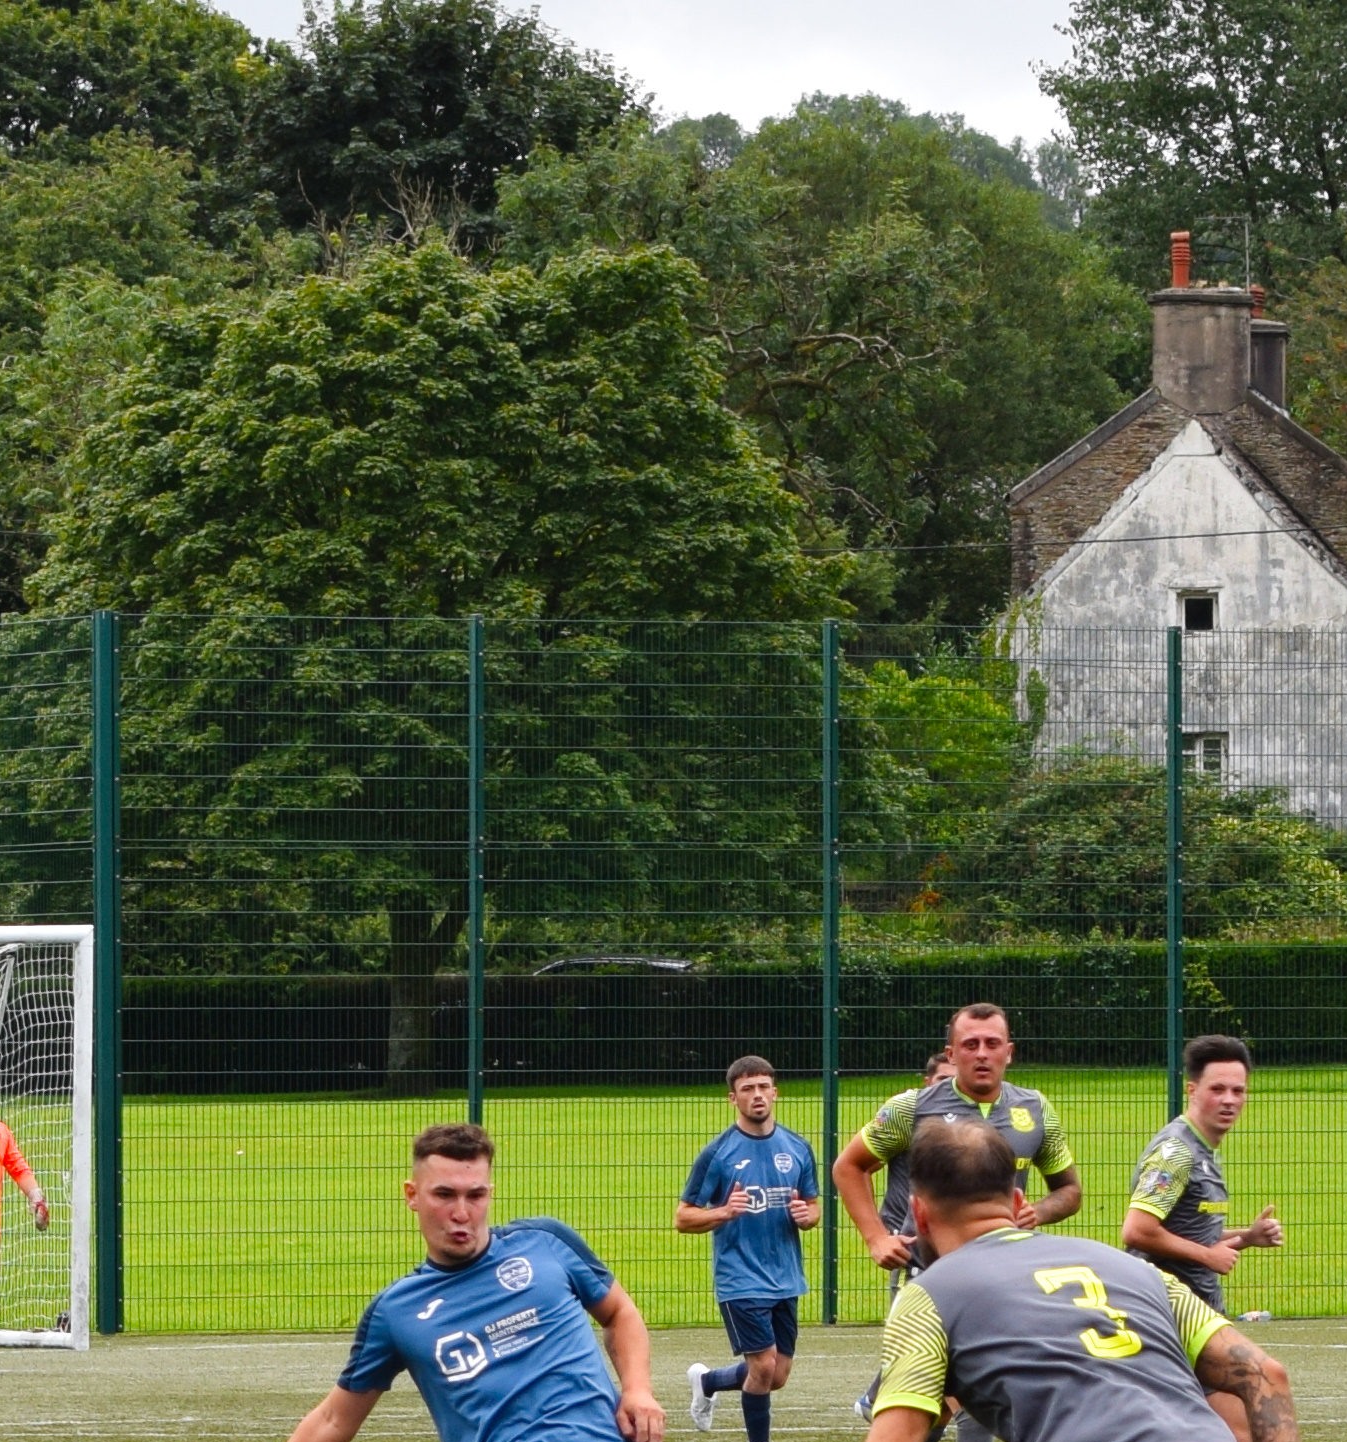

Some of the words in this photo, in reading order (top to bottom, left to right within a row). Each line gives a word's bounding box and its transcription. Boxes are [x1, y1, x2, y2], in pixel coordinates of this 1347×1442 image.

[484, 1323, 496, 1334] GJ
[496, 1307, 537, 1330] PROPERTY
[1034, 1266, 1143, 1358] 3
